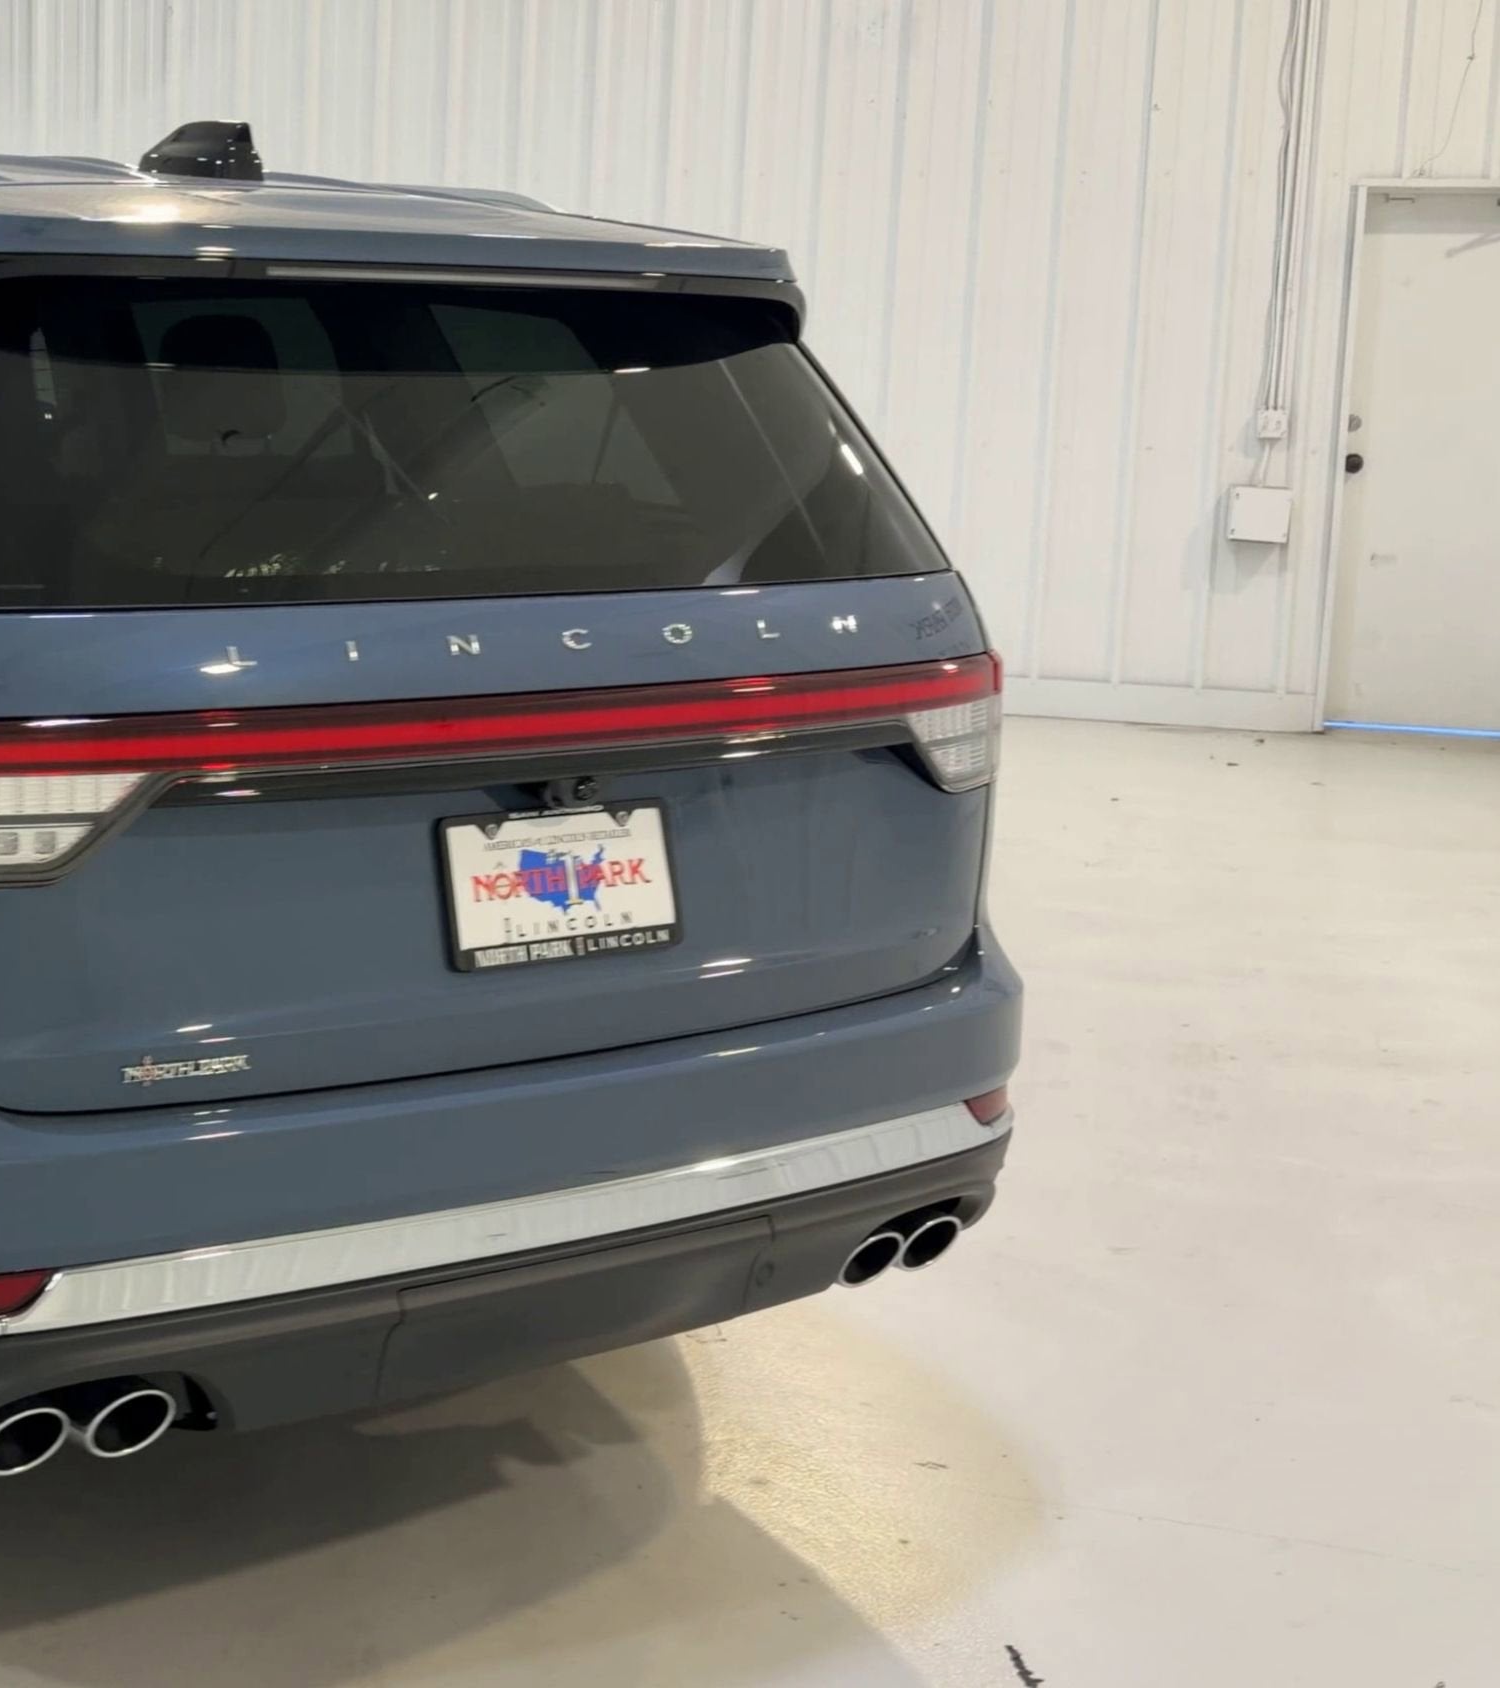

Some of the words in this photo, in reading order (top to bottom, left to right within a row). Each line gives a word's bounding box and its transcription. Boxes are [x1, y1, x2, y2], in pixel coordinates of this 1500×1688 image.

[226, 615, 858, 666] LINCOLN
[471, 865, 566, 902] NORTH
[575, 858, 653, 889] PARK
[515, 911, 633, 938] LINCOLN
[529, 938, 574, 961] PARK
[586, 929, 670, 952] LINCOLN
